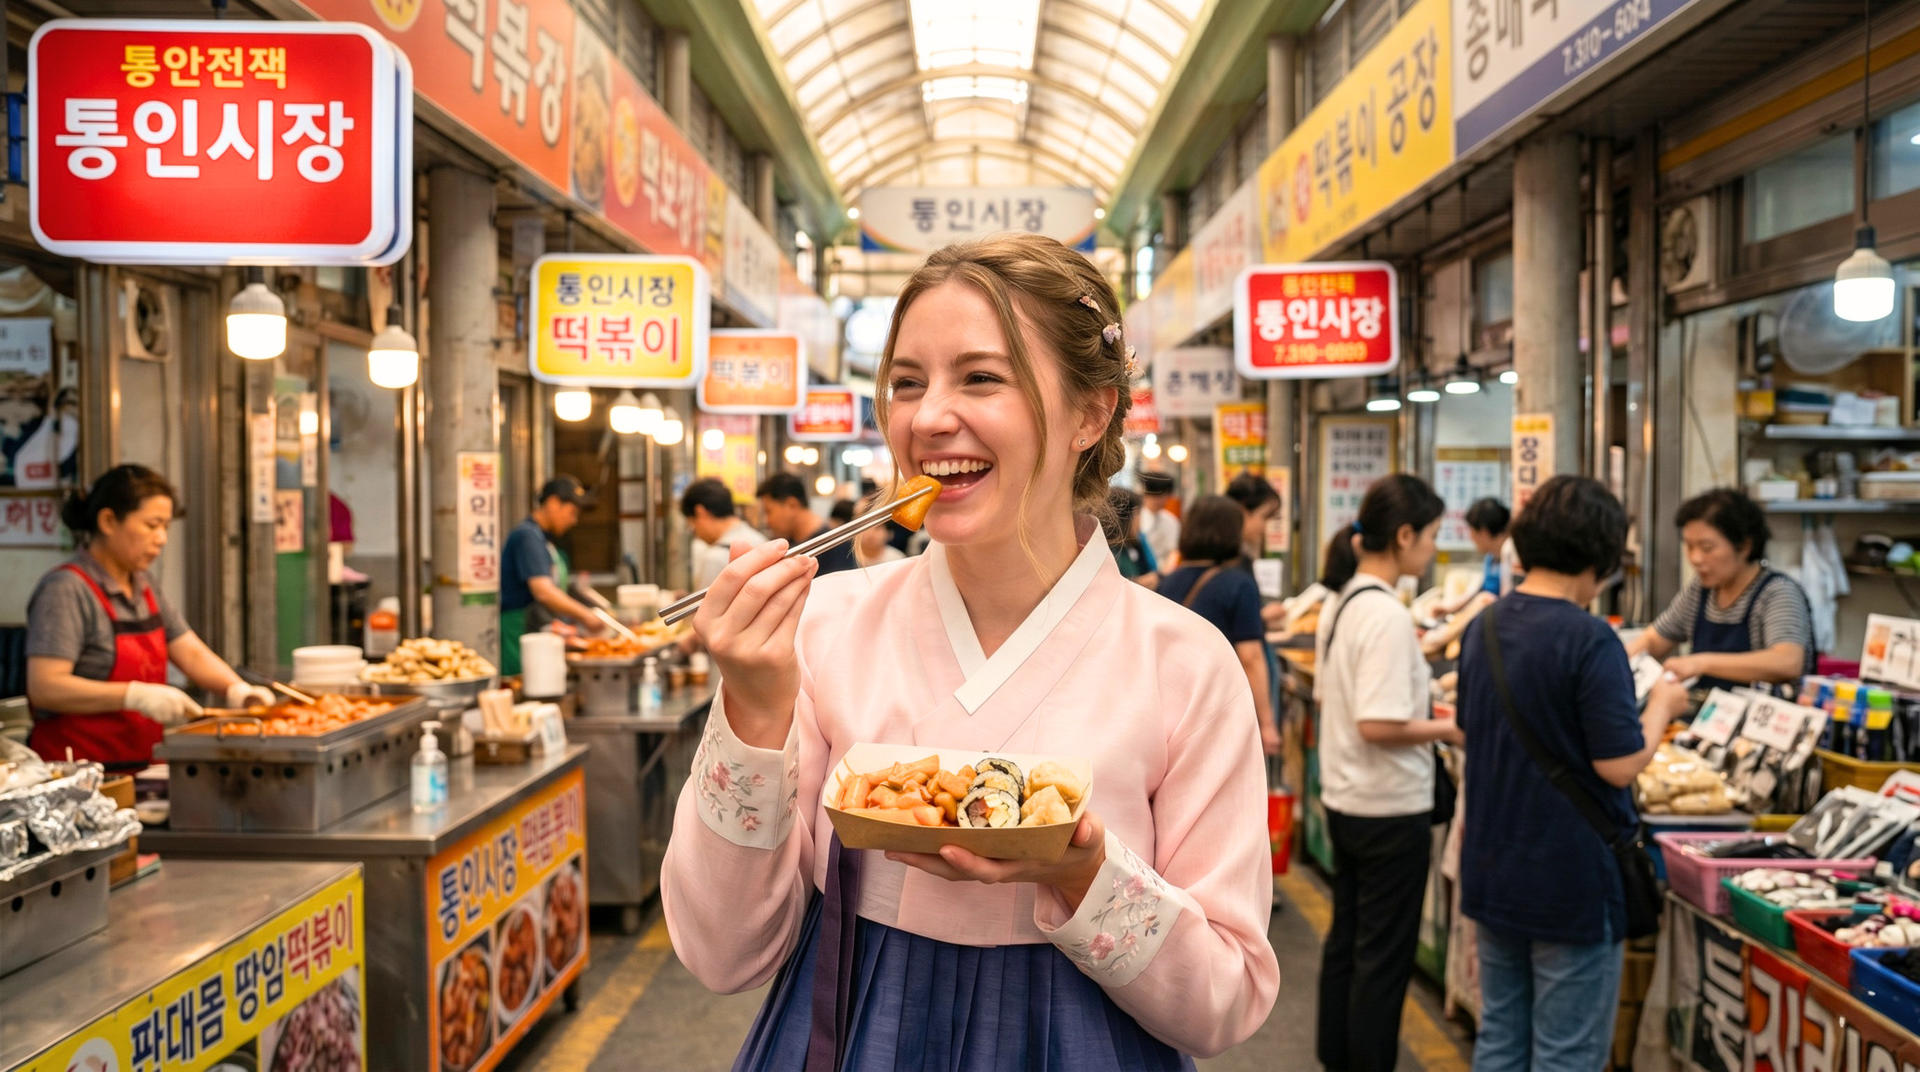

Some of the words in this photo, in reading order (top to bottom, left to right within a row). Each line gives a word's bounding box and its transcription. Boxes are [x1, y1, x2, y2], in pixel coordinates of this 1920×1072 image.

[1386, 25, 1438, 156] 공장
[55, 98, 355, 183] 통인시장
[910, 198, 1048, 233] 통인시장
[556, 273, 675, 308] 통인시장
[552, 315, 679, 364] 떡볶이
[1254, 296, 1386, 342] 통인시장
